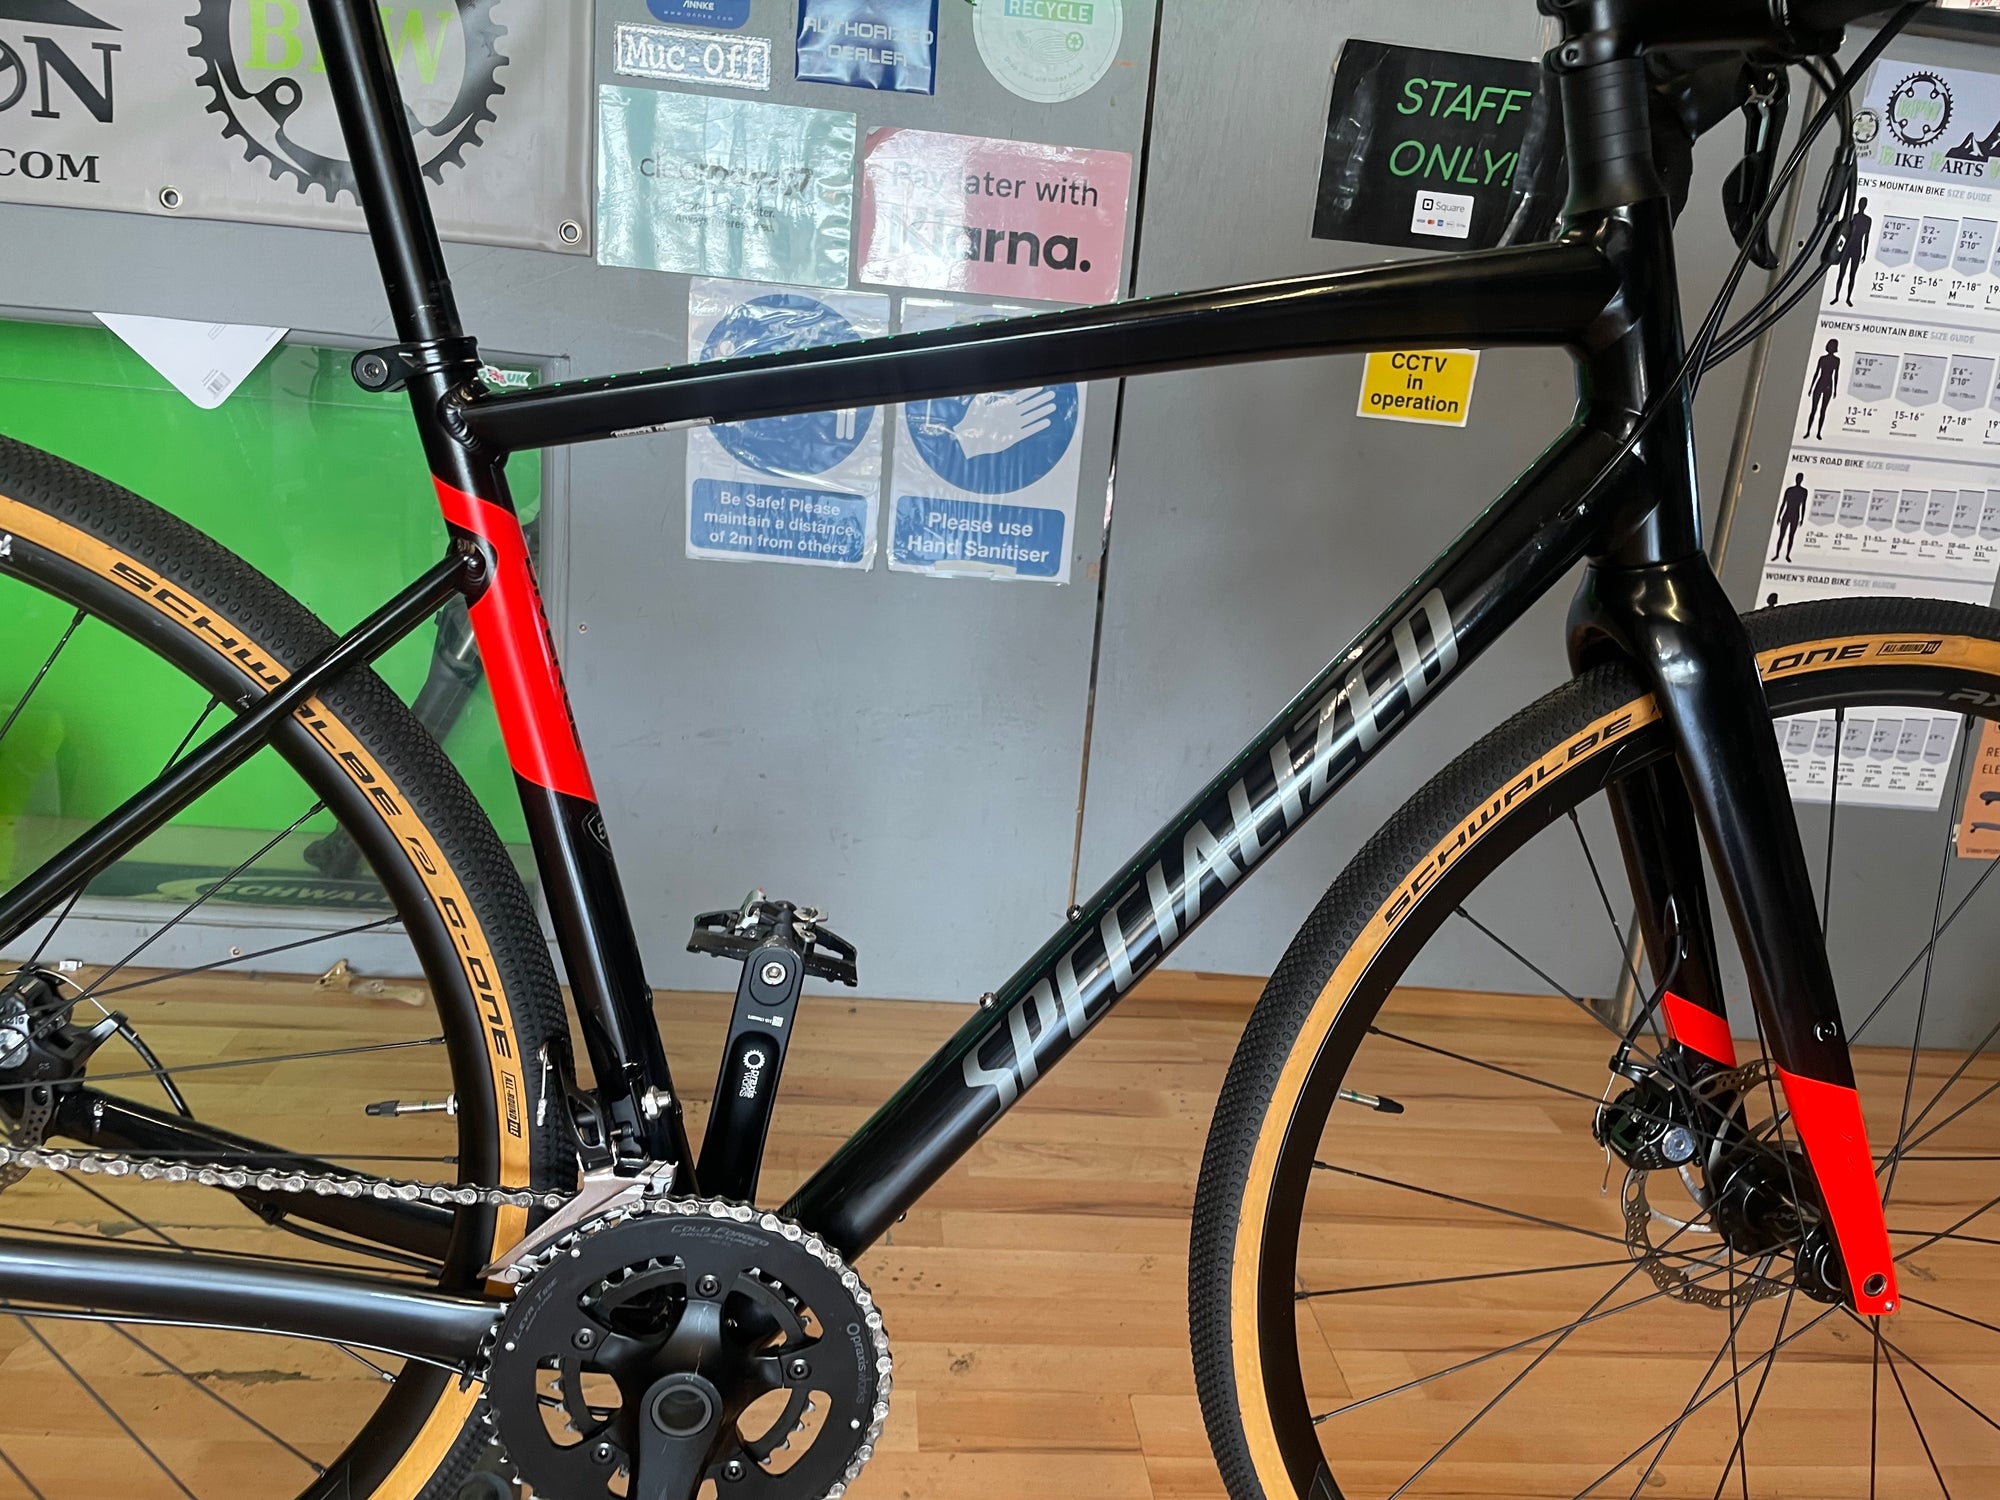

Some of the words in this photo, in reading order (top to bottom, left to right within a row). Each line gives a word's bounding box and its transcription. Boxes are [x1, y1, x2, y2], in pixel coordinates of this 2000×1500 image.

[1009, 0, 1089, 22] RECYCLE
[804, 16, 934, 45] AUTHORIZED
[244, 0, 454, 85] BW
[625, 34, 762, 81] Muc-Off
[828, 45, 907, 67] DEALER
[1397, 78, 1532, 124] STAFF
[1389, 140, 1519, 188] ONLY!
[1036, 178, 1098, 207] with
[1857, 178, 1877, 188] EN'S
[1879, 181, 1923, 194] MOUNTAIN
[1926, 187, 1945, 197] BIKE
[1947, 190, 1964, 199] SIZE
[1967, 192, 1992, 203] GUIDE
[1435, 201, 1465, 213] Square
[1872, 282, 1884, 291] XS
[1909, 287, 1916, 295] S
[1948, 291, 1957, 300] M
[1986, 295, 1991, 303] L
[1820, 320, 1860, 331] WOMEN'S
[1862, 325, 1907, 337] MOUNTAIN
[1908, 329, 1929, 339] BIKE
[1930, 331, 1947, 340] SIZE
[1950, 333, 1975, 344] GUIDE
[1391, 353, 1448, 373] CCTV
[507, 373, 526, 384] UK
[1408, 374, 1422, 390] in
[1370, 392, 1459, 414] operation
[1844, 417, 1856, 425] XS
[1891, 421, 1897, 429] S
[1939, 425, 1948, 434] M
[1985, 430, 1990, 438] L
[1791, 454, 1817, 464] MEN'S
[1819, 457, 1842, 466] ROAD
[1844, 459, 1864, 468] BIKE
[720, 492, 740, 505] Be
[745, 494, 785, 510] Safe!
[789, 498, 841, 516] Please
[703, 512, 770, 529] maintain
[775, 520, 784, 530] a
[789, 518, 854, 536] distance
[928, 512, 993, 533] Please
[998, 522, 1033, 537] use
[709, 530, 726, 543] of
[729, 532, 752, 546] 2m
[757, 534, 793, 549] from
[798, 540, 848, 555] others
[907, 535, 960, 555] Hand
[965, 540, 1050, 563] Sanitiser
[1765, 572, 1804, 582] WOMEN'S
[1807, 575, 1830, 584] ROAD
[1831, 578, 1851, 586] BIKE
[1384, 713, 1633, 927] SCHWALBE
[962, 586, 1459, 1136] SPECIALIZED
[440, 896, 513, 1060] G-ONE
